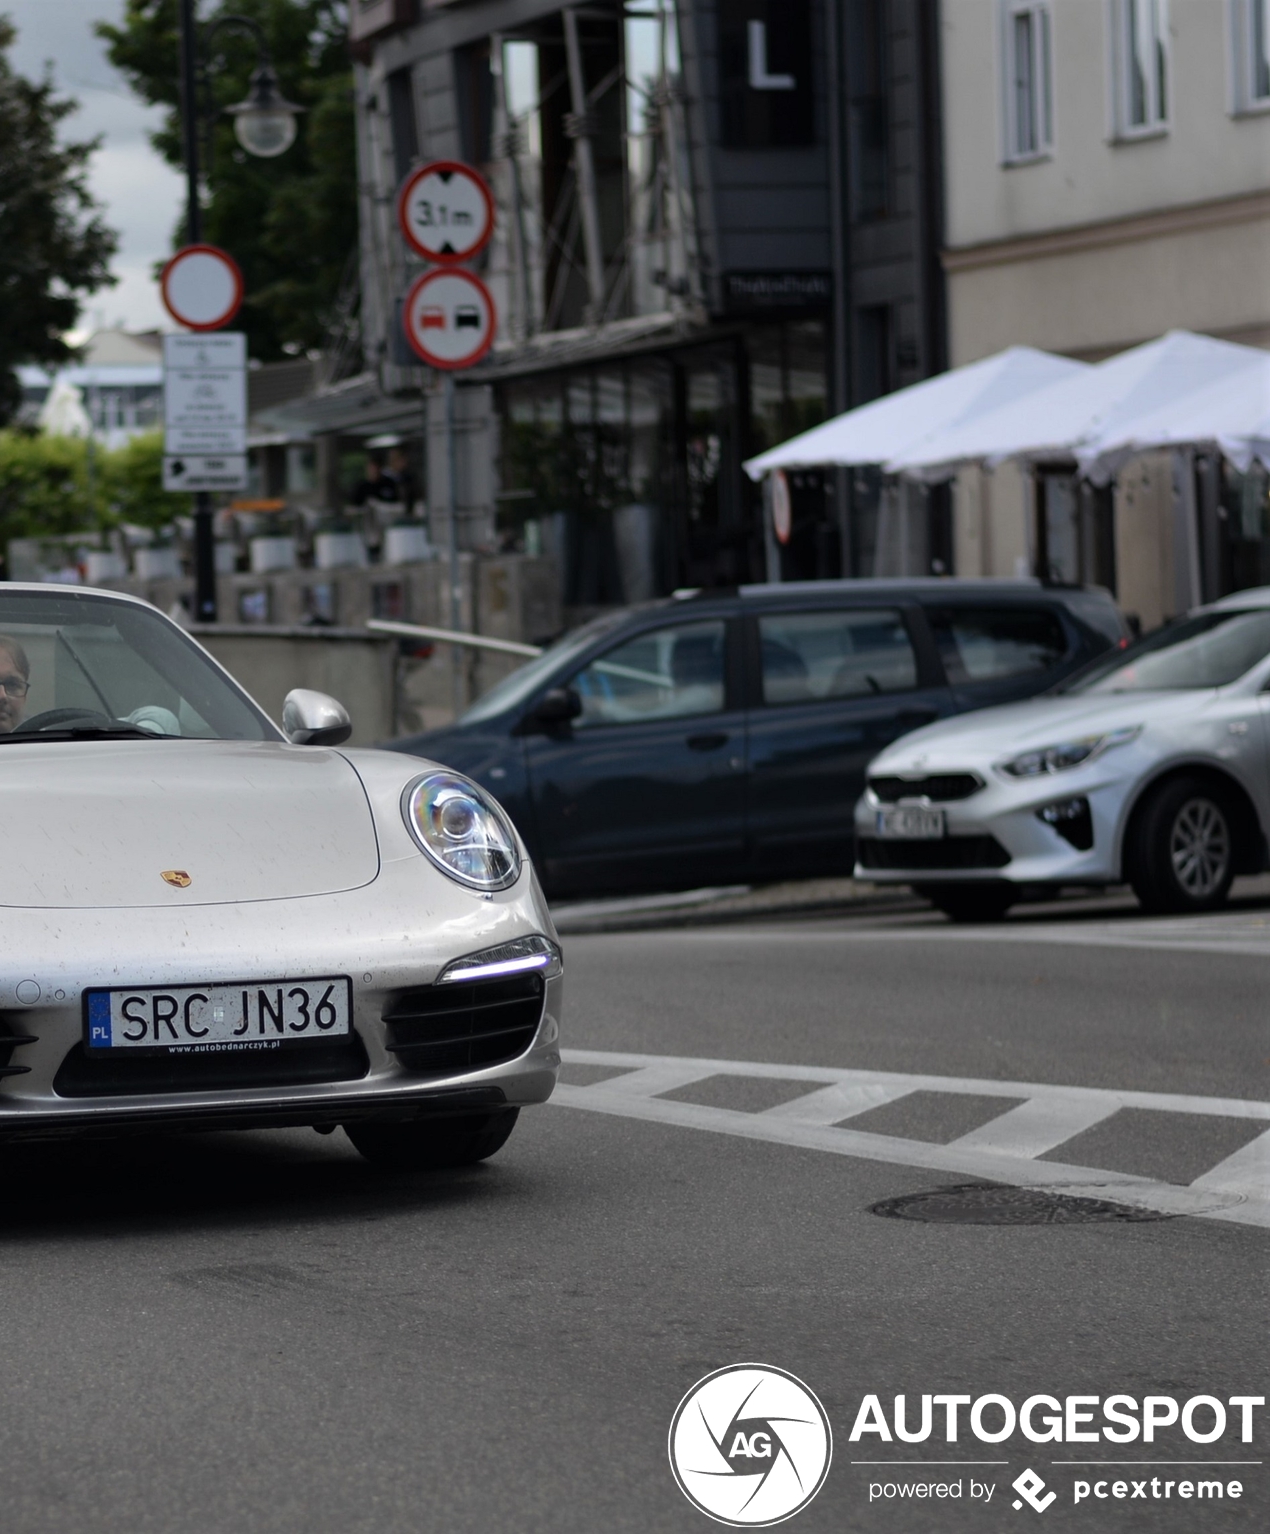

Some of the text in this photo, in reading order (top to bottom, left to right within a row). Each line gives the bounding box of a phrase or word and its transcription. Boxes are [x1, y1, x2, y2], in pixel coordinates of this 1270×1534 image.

[749, 21, 794, 89] L
[121, 984, 337, 1041] SRC JN36
[92, 1026, 109, 1039] PL
[168, 1040, 281, 1053] www.autobednarczyk.pl
